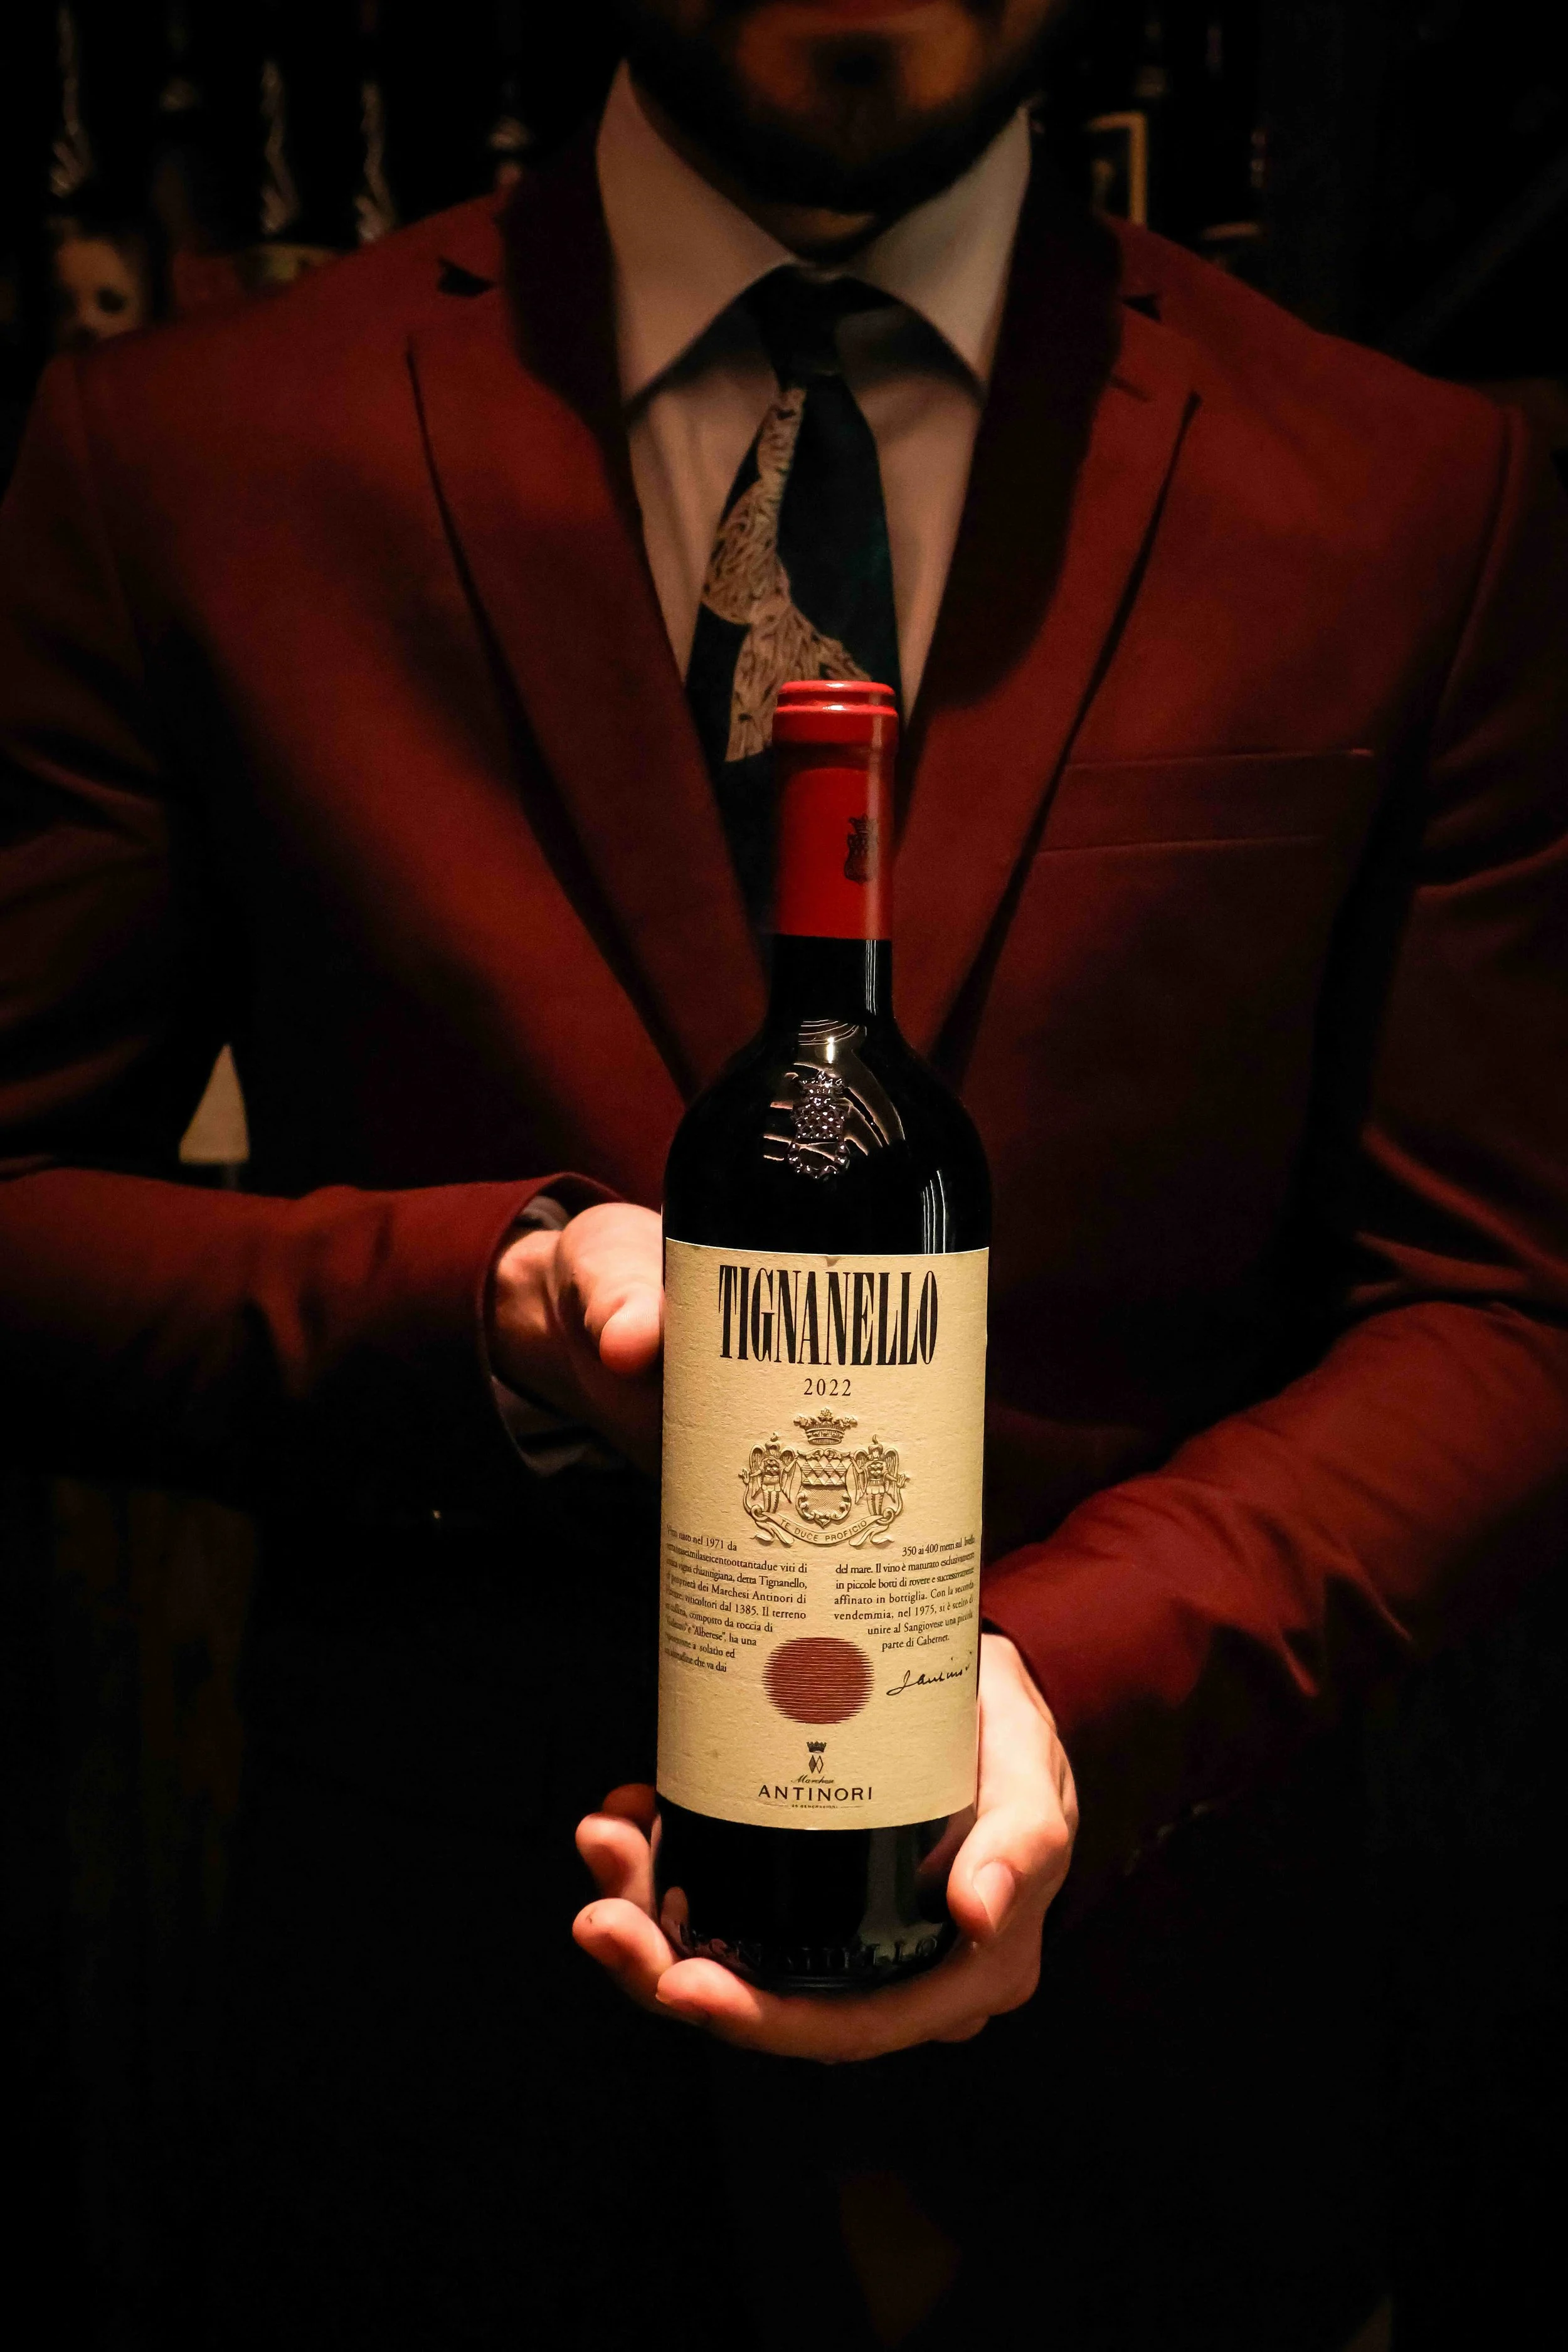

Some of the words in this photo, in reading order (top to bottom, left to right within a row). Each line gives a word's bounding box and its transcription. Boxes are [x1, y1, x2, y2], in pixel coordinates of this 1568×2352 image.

[719, 1265, 938, 1365] TIGNANELLO
[803, 1378, 852, 1396] 2022
[780, 1519, 790, 1528] TE
[795, 1528, 819, 1541] DUCE
[825, 1520, 867, 1542] PROFICIO
[693, 1534, 703, 1545] nel
[705, 1537, 724, 1550] 1971
[727, 1541, 737, 1551] da
[902, 1545, 916, 1557] 350
[918, 1545, 924, 1555] ai
[925, 1543, 938, 1554] 400
[940, 1542, 955, 1552] metri
[780, 1563, 795, 1572] viti
[798, 1564, 807, 1572] di
[835, 1564, 848, 1574] del
[850, 1565, 873, 1574] mare.
[876, 1563, 881, 1573] Il
[883, 1562, 900, 1572] vino
[902, 1563, 906, 1571] è
[908, 1558, 940, 1571] maturato
[693, 1565, 735, 1582] chiantigiana,
[737, 1573, 756, 1584] detta
[759, 1576, 807, 1589] Tignanello,
[836, 1581, 844, 1589] in
[847, 1578, 877, 1592] piccole
[878, 1577, 898, 1588] botti
[899, 1577, 907, 1587] di
[909, 1576, 930, 1586] rovere
[698, 1581, 709, 1592] dei
[711, 1586, 750, 1599] Marchesi
[752, 1591, 793, 1602] Antinori
[797, 1594, 806, 1603] di
[834, 1593, 872, 1605] affinato
[876, 1594, 886, 1603] in
[889, 1591, 928, 1604] bottiglia.
[930, 1588, 946, 1598] Con
[948, 1585, 953, 1596] la
[686, 1594, 717, 1609] viticoltori
[720, 1602, 731, 1612] dal
[736, 1604, 759, 1616] 1385.
[762, 1607, 768, 1616] Il
[772, 1609, 806, 1619] terreno
[834, 1611, 894, 1621] vendemmia,
[898, 1607, 911, 1617] nel
[915, 1605, 937, 1617] 1975,
[940, 1602, 945, 1612] si
[947, 1602, 951, 1611] è
[953, 1597, 968, 1609] scelto
[689, 1612, 723, 1625] composto
[724, 1616, 734, 1627] da
[736, 1620, 761, 1631] roccia
[764, 1622, 773, 1632] di
[867, 1624, 891, 1635] unire
[893, 1622, 901, 1633] al
[904, 1618, 943, 1634] Sangiovese
[945, 1616, 956, 1626] una
[692, 1625, 726, 1641] "Alberese",
[729, 1634, 739, 1643] ha
[741, 1638, 757, 1646] una
[882, 1640, 904, 1652] parte
[906, 1637, 914, 1646] di
[916, 1634, 950, 1646] Cabernet.
[726, 1648, 736, 1658] ed
[694, 1656, 705, 1667] che
[716, 1660, 727, 1672] dai
[758, 1785, 872, 1801] ANTINORI
